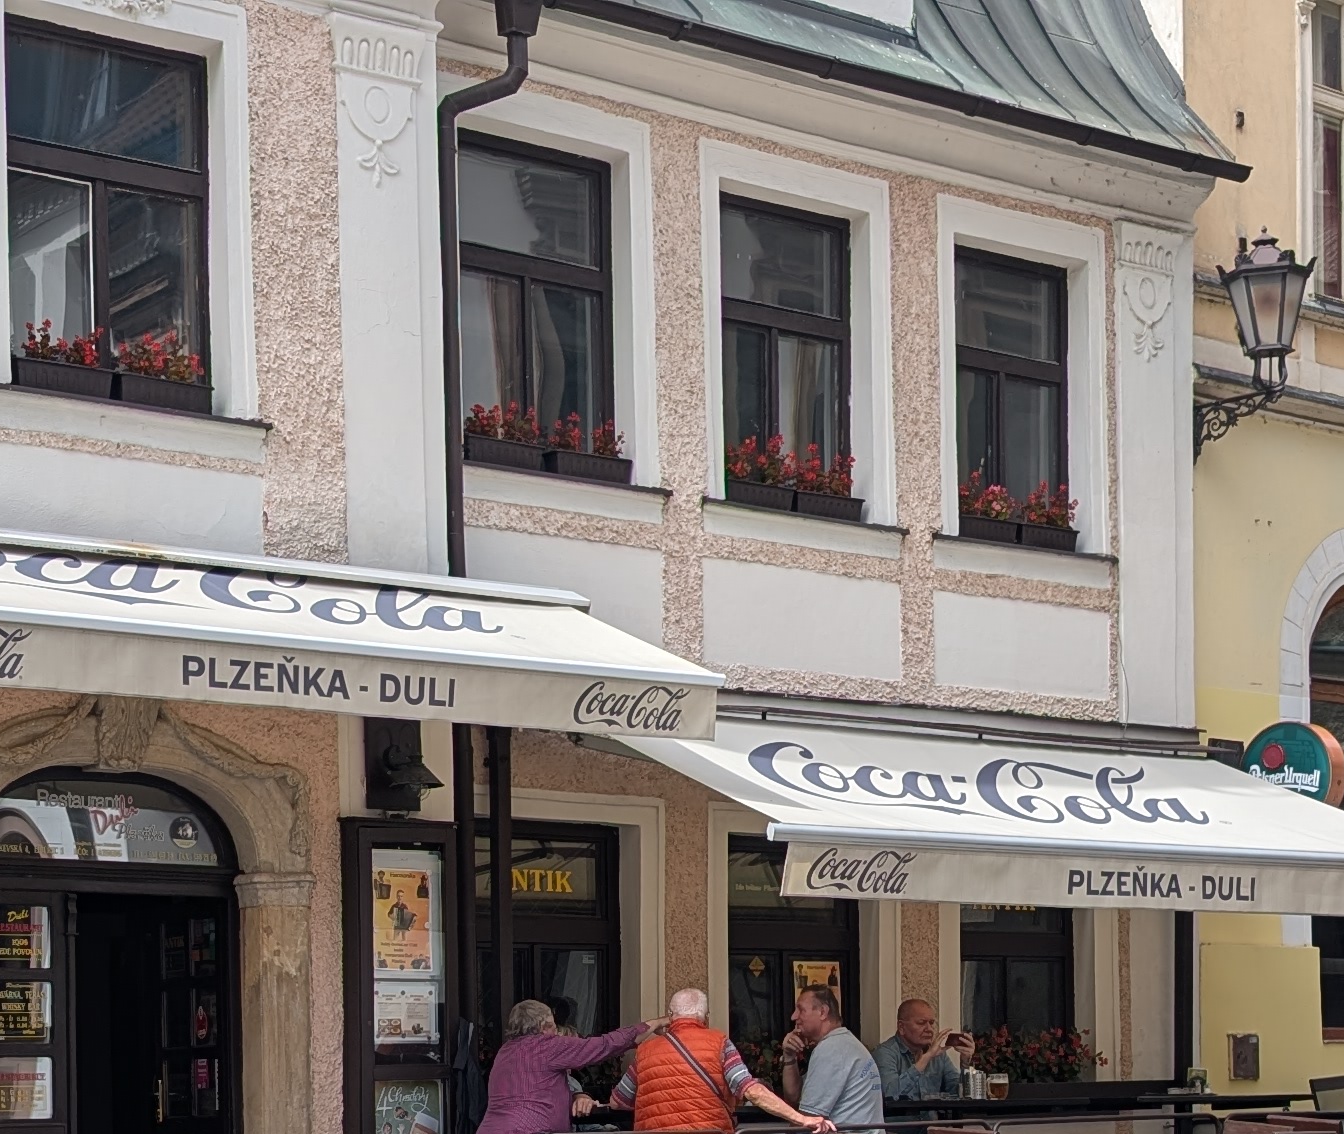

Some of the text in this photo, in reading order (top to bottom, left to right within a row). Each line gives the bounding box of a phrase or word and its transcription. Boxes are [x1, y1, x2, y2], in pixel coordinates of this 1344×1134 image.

[182, 655, 350, 701] PLZEŇKA
[380, 672, 456, 708] DULI
[573, 681, 690, 732] Coca-Cola
[36, 789, 119, 810] Restaurant
[749, 741, 1209, 825] Coca-Cola
[1283, 764, 1321, 793] Urquell
[512, 868, 573, 894] NTIK
[806, 847, 917, 898] Coca-Cola
[1067, 864, 1182, 900] PLZEŇKA
[1202, 874, 1257, 902] DULI
